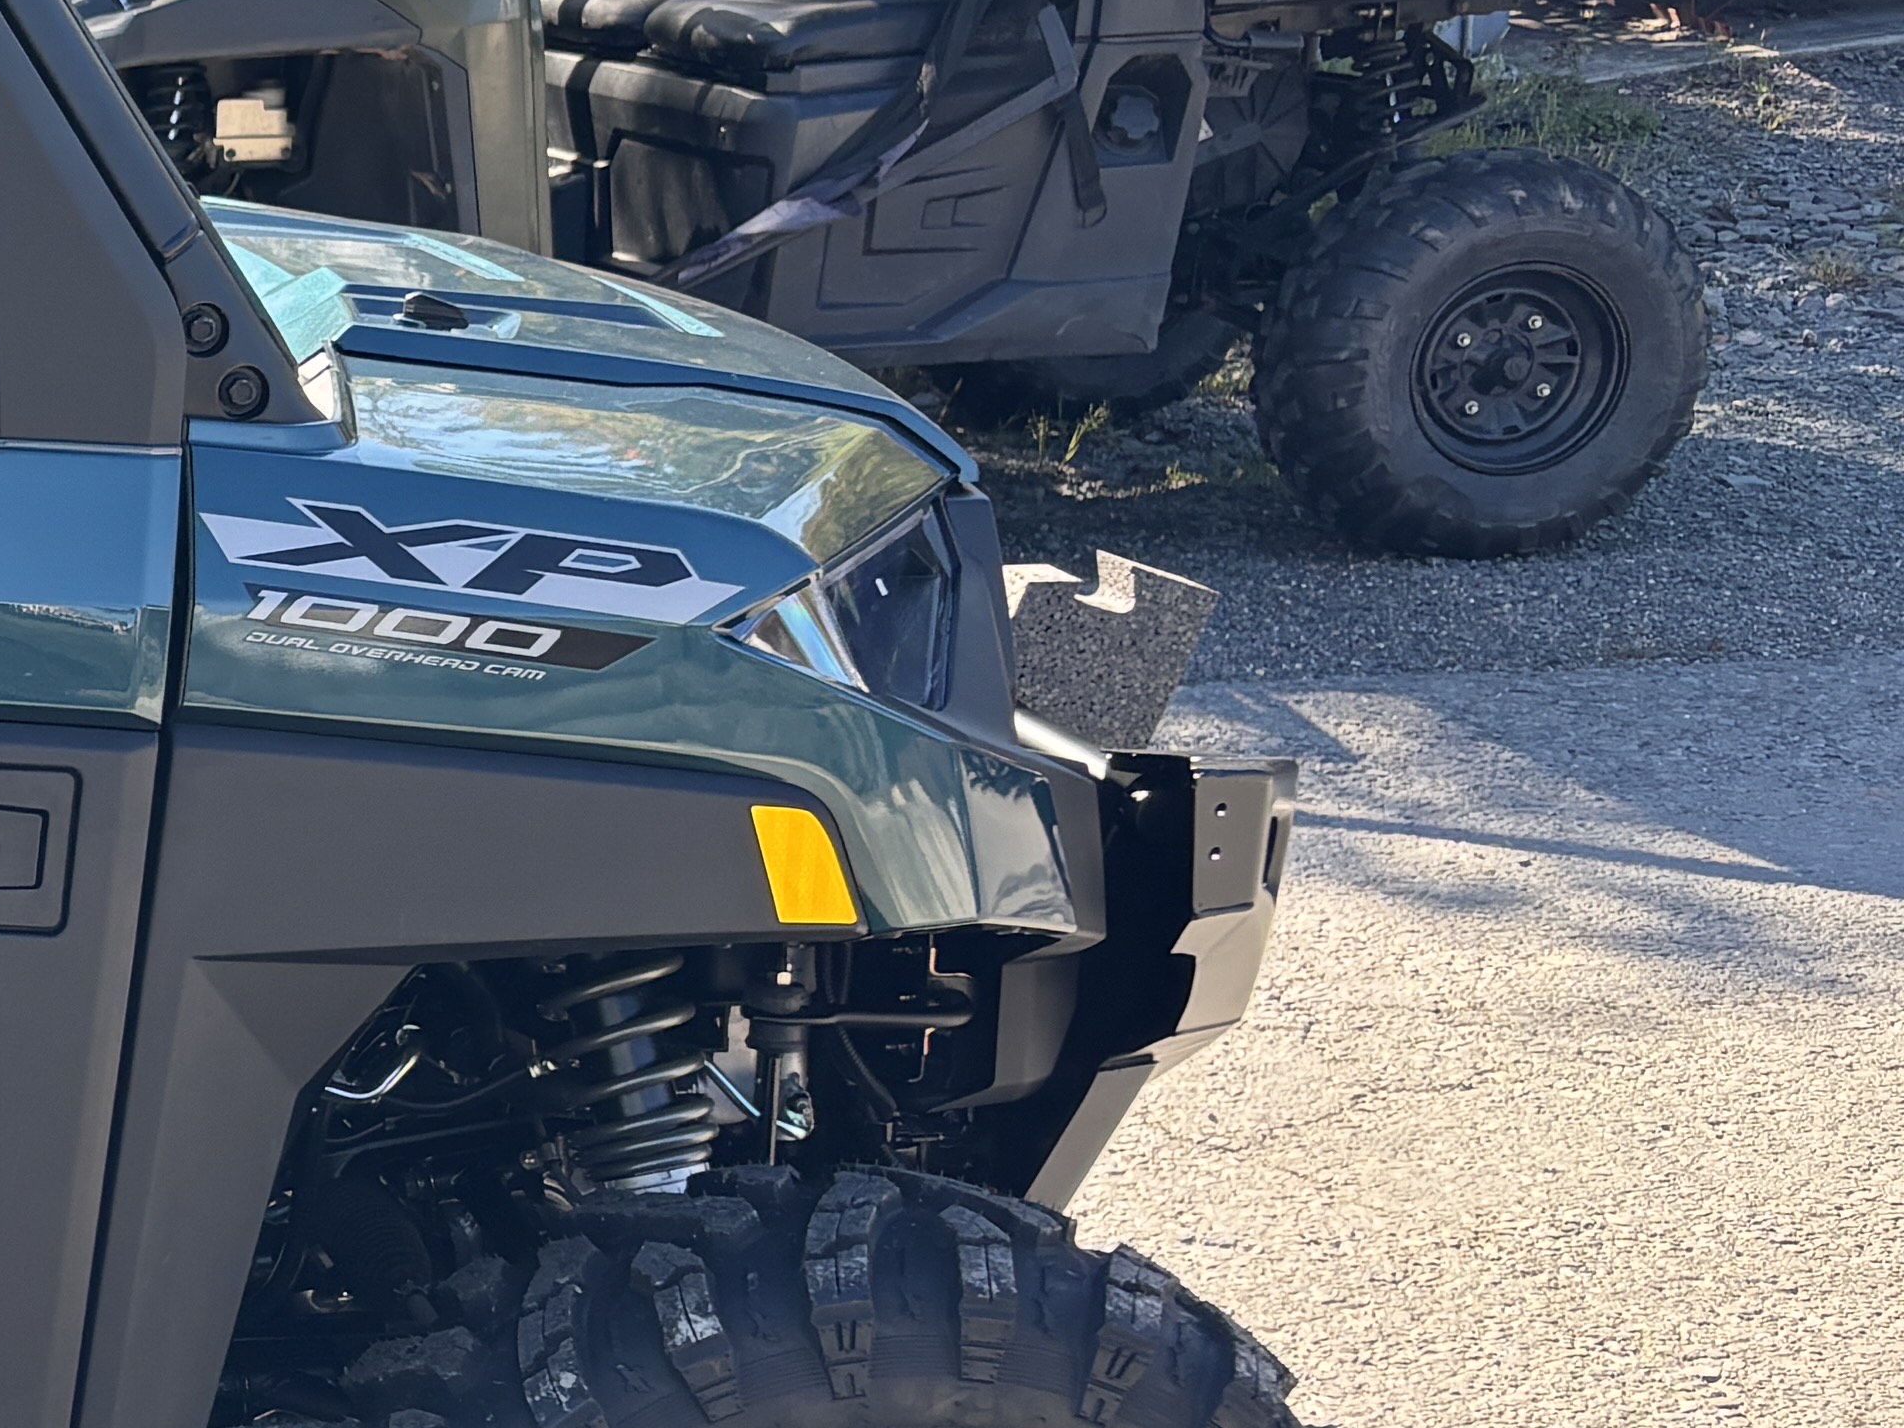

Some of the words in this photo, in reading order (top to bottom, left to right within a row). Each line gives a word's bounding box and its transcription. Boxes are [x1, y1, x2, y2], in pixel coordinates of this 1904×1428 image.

[233, 497, 694, 596] XP
[245, 631, 321, 650] DUAL
[328, 643, 481, 673] OVERHEAD
[483, 663, 548, 680] CAM
[246, 589, 562, 657] 1000
